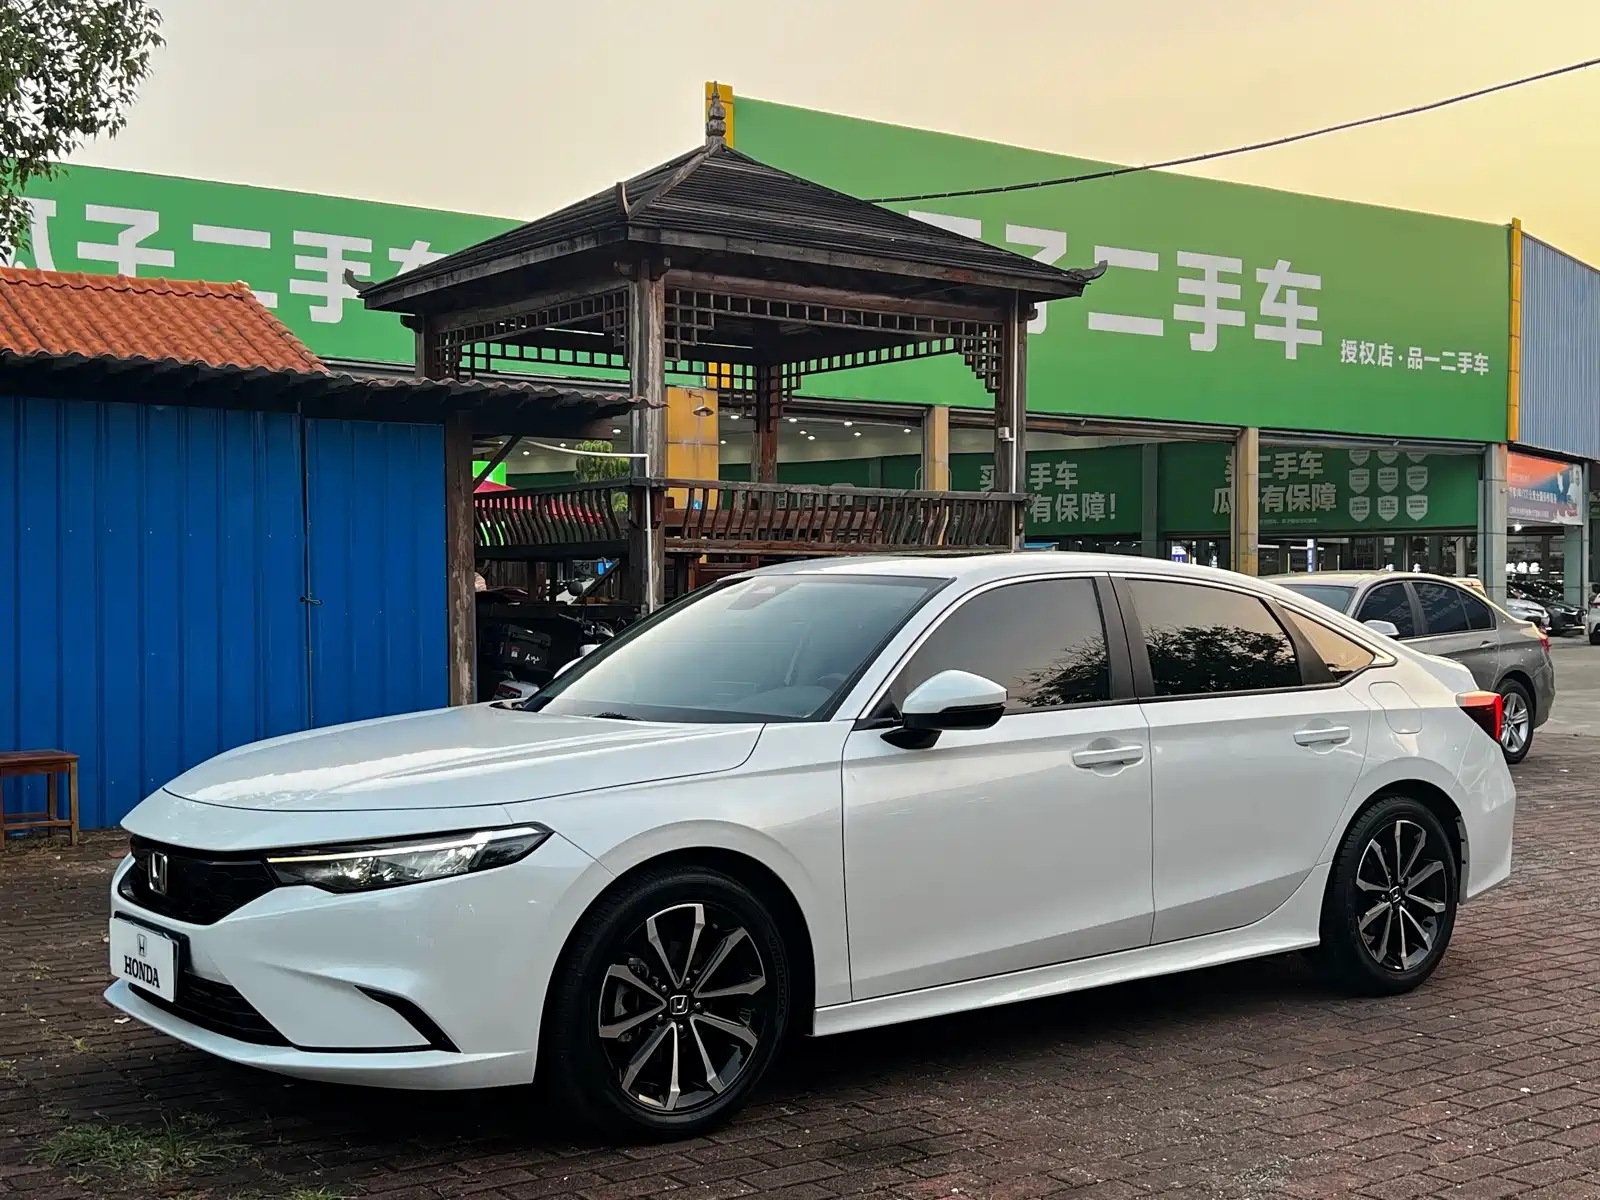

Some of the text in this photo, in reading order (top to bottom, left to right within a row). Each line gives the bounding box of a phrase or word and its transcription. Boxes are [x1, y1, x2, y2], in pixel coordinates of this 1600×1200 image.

[1225, 450, 1324, 482] 二手车
[1024, 491, 1116, 523] 有保障!
[1212, 482, 1337, 515] 瓜有保障
[124, 954, 160, 989] HONDA
